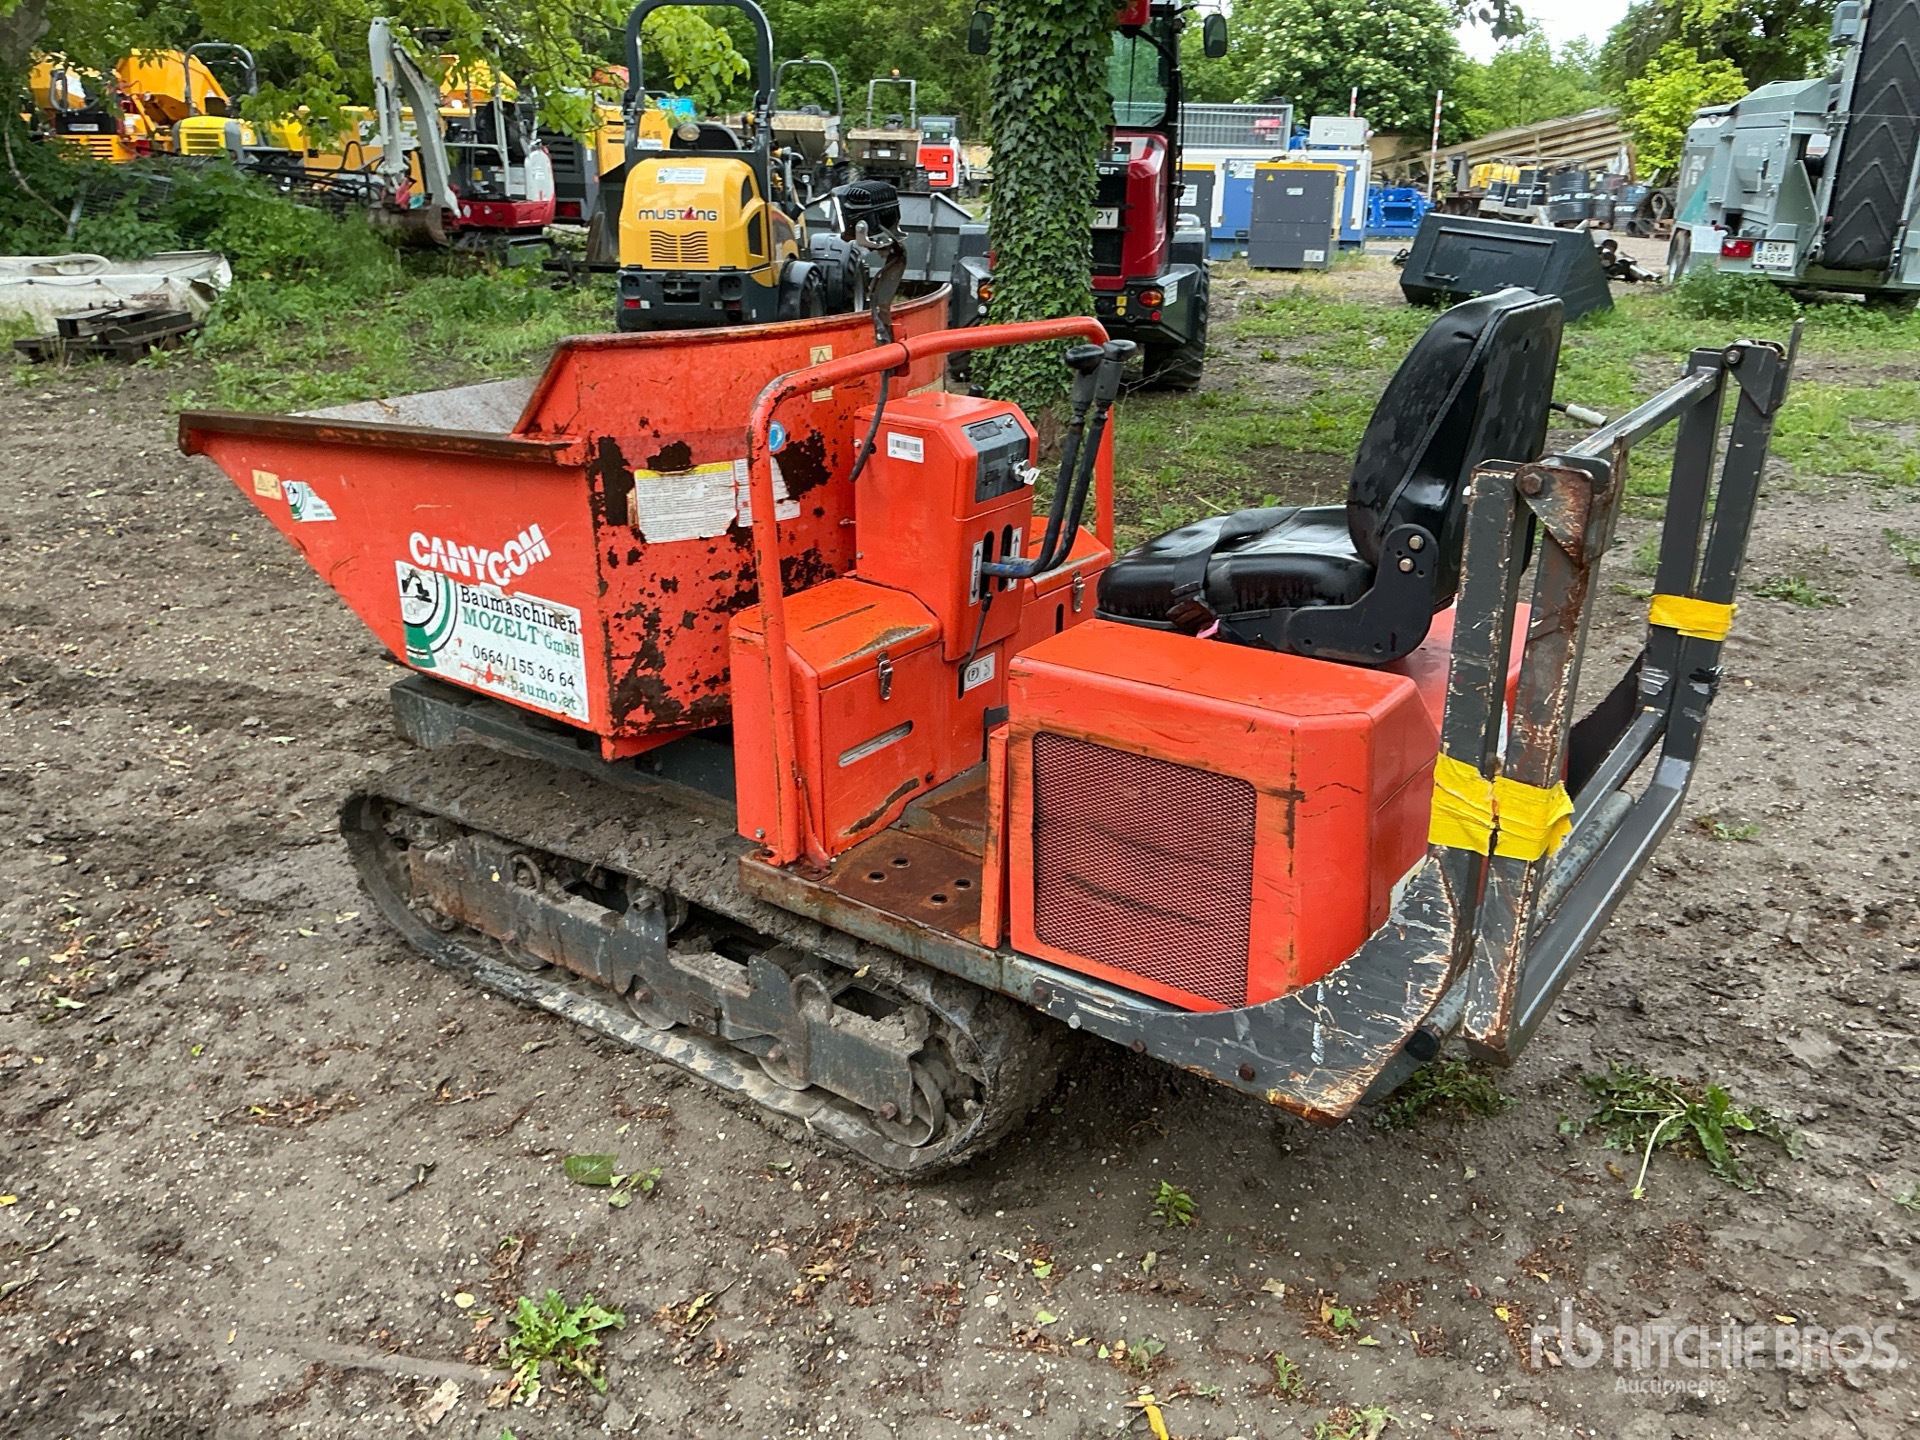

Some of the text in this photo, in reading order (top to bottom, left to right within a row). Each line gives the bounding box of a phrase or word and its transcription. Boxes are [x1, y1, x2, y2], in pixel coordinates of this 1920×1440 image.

[639, 207, 718, 221] MUSTANG
[409, 523, 552, 586] CANYCOM
[460, 585, 579, 635] Baumaschinen
[461, 606, 582, 659] MOZELT GmbH
[472, 645, 576, 689] 0664/155 36 64
[477, 667, 578, 711] .baumo.at
